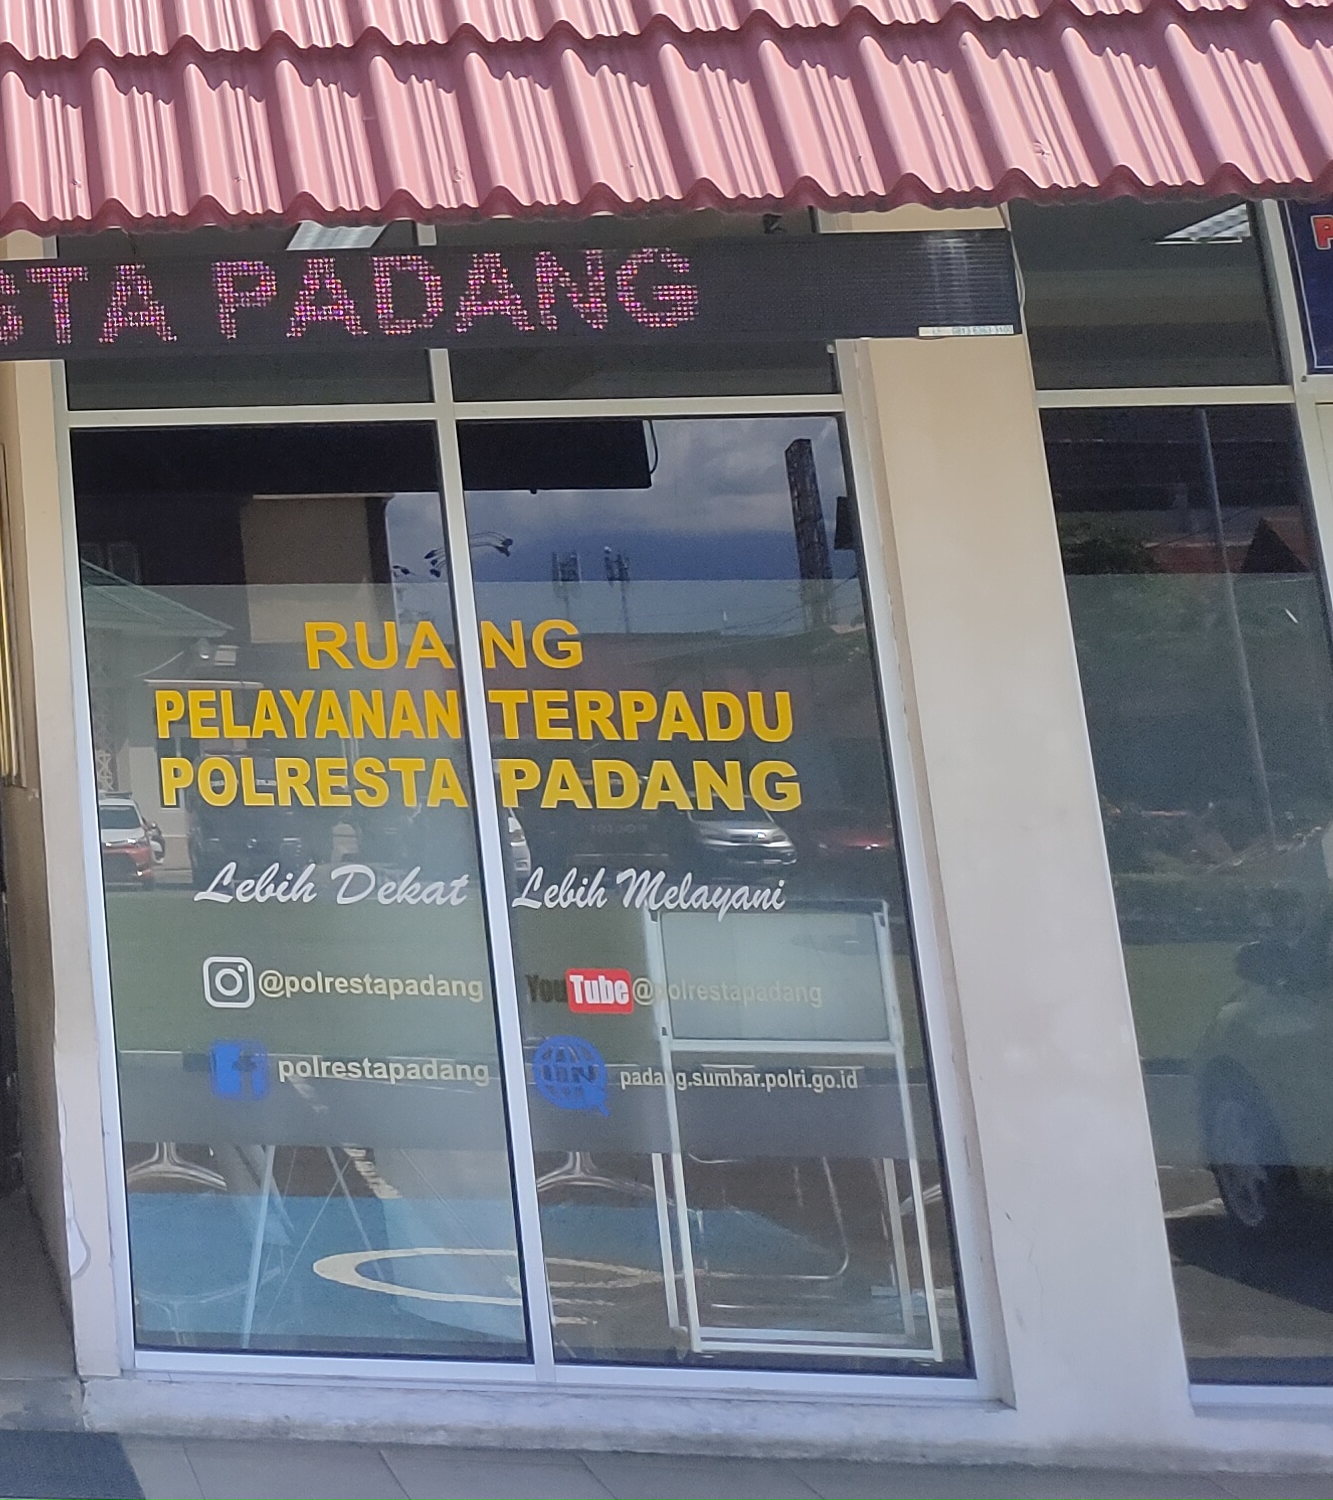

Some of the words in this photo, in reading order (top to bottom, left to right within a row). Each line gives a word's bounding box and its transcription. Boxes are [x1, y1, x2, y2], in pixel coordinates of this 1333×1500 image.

[211, 246, 700, 342] PADANG
[304, 617, 585, 670] RUANG
[154, 688, 463, 741] PELAYANAN
[483, 689, 794, 744] TERPADU
[160, 756, 469, 809] POLRESTA
[497, 758, 803, 813] PADANG
[193, 861, 318, 904] Lebih
[330, 863, 471, 908] Dekat
[511, 866, 609, 912] Lebih
[614, 866, 786, 923] Melayani
[258, 969, 484, 1003] @polrestapadang
[278, 1057, 490, 1087] polrestapadang
